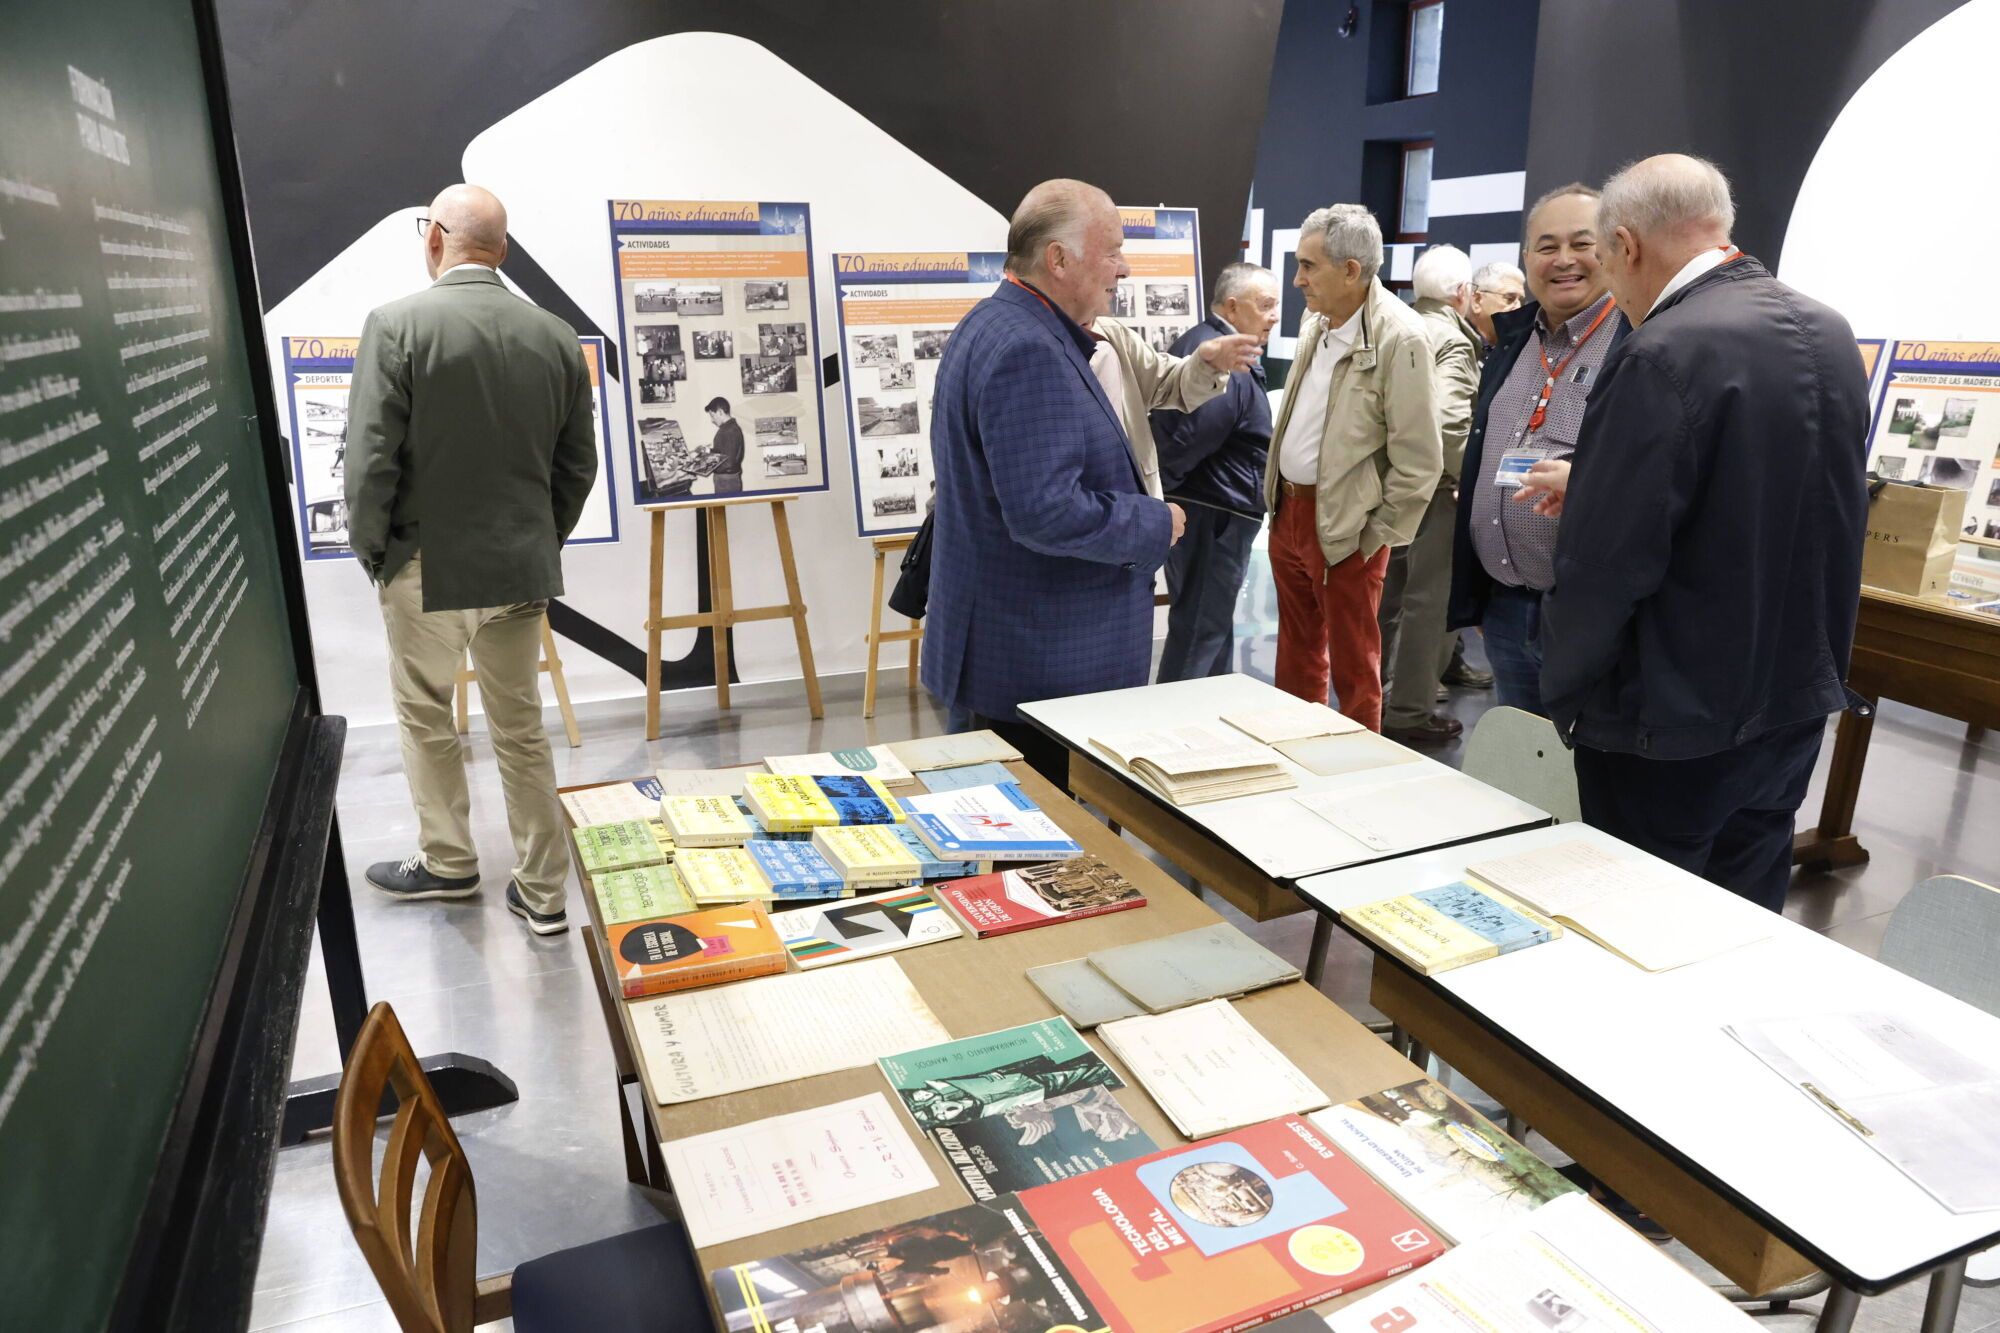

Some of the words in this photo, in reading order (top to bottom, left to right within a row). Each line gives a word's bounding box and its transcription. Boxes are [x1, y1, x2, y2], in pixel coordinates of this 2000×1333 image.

[616, 202, 643, 221] 70
[647, 207, 681, 222] años
[685, 205, 754, 223] educando
[1122, 213, 1151, 227] ando
[627, 241, 670, 249] ACTIVIDADES
[841, 255, 865, 272] 70
[868, 258, 898, 272] años
[902, 257, 964, 272] educando
[850, 290, 888, 298] ACTIVIDADES
[293, 339, 324, 359] 70
[329, 344, 359, 359] año
[1901, 343, 1926, 361] 70
[1927, 347, 1965, 362] años
[305, 375, 343, 383] DEPORTES
[1900, 375, 1937, 384] CONVENTO
[1938, 376, 1947, 384] DE
[1964, 377, 1991, 386] MADRES
[1866, 530, 1900, 543] PERS
[950, 889, 990, 925] UNIVERSIDAD
[972, 899, 1001, 923] LABORAL
[998, 913, 1012, 921] DE
[643, 931, 660, 949] ESCUELA
[659, 930, 675, 943] SOCIAL
[653, 1003, 676, 1036] HUMOR
[967, 1037, 1029, 1056] NOMBRAMIENTO
[914, 1056, 948, 1070] MANDOS
[951, 1053, 963, 1062] DE
[671, 1052, 698, 1095] CULTURA
[1285, 1122, 1334, 1159] EVEREST
[1088, 1187, 1156, 1256] TECNOLOGIA
[1144, 1207, 1187, 1245] METAL
[1140, 1226, 1171, 1250] DEL
[1387, 1261, 1412, 1276] EVEREST
